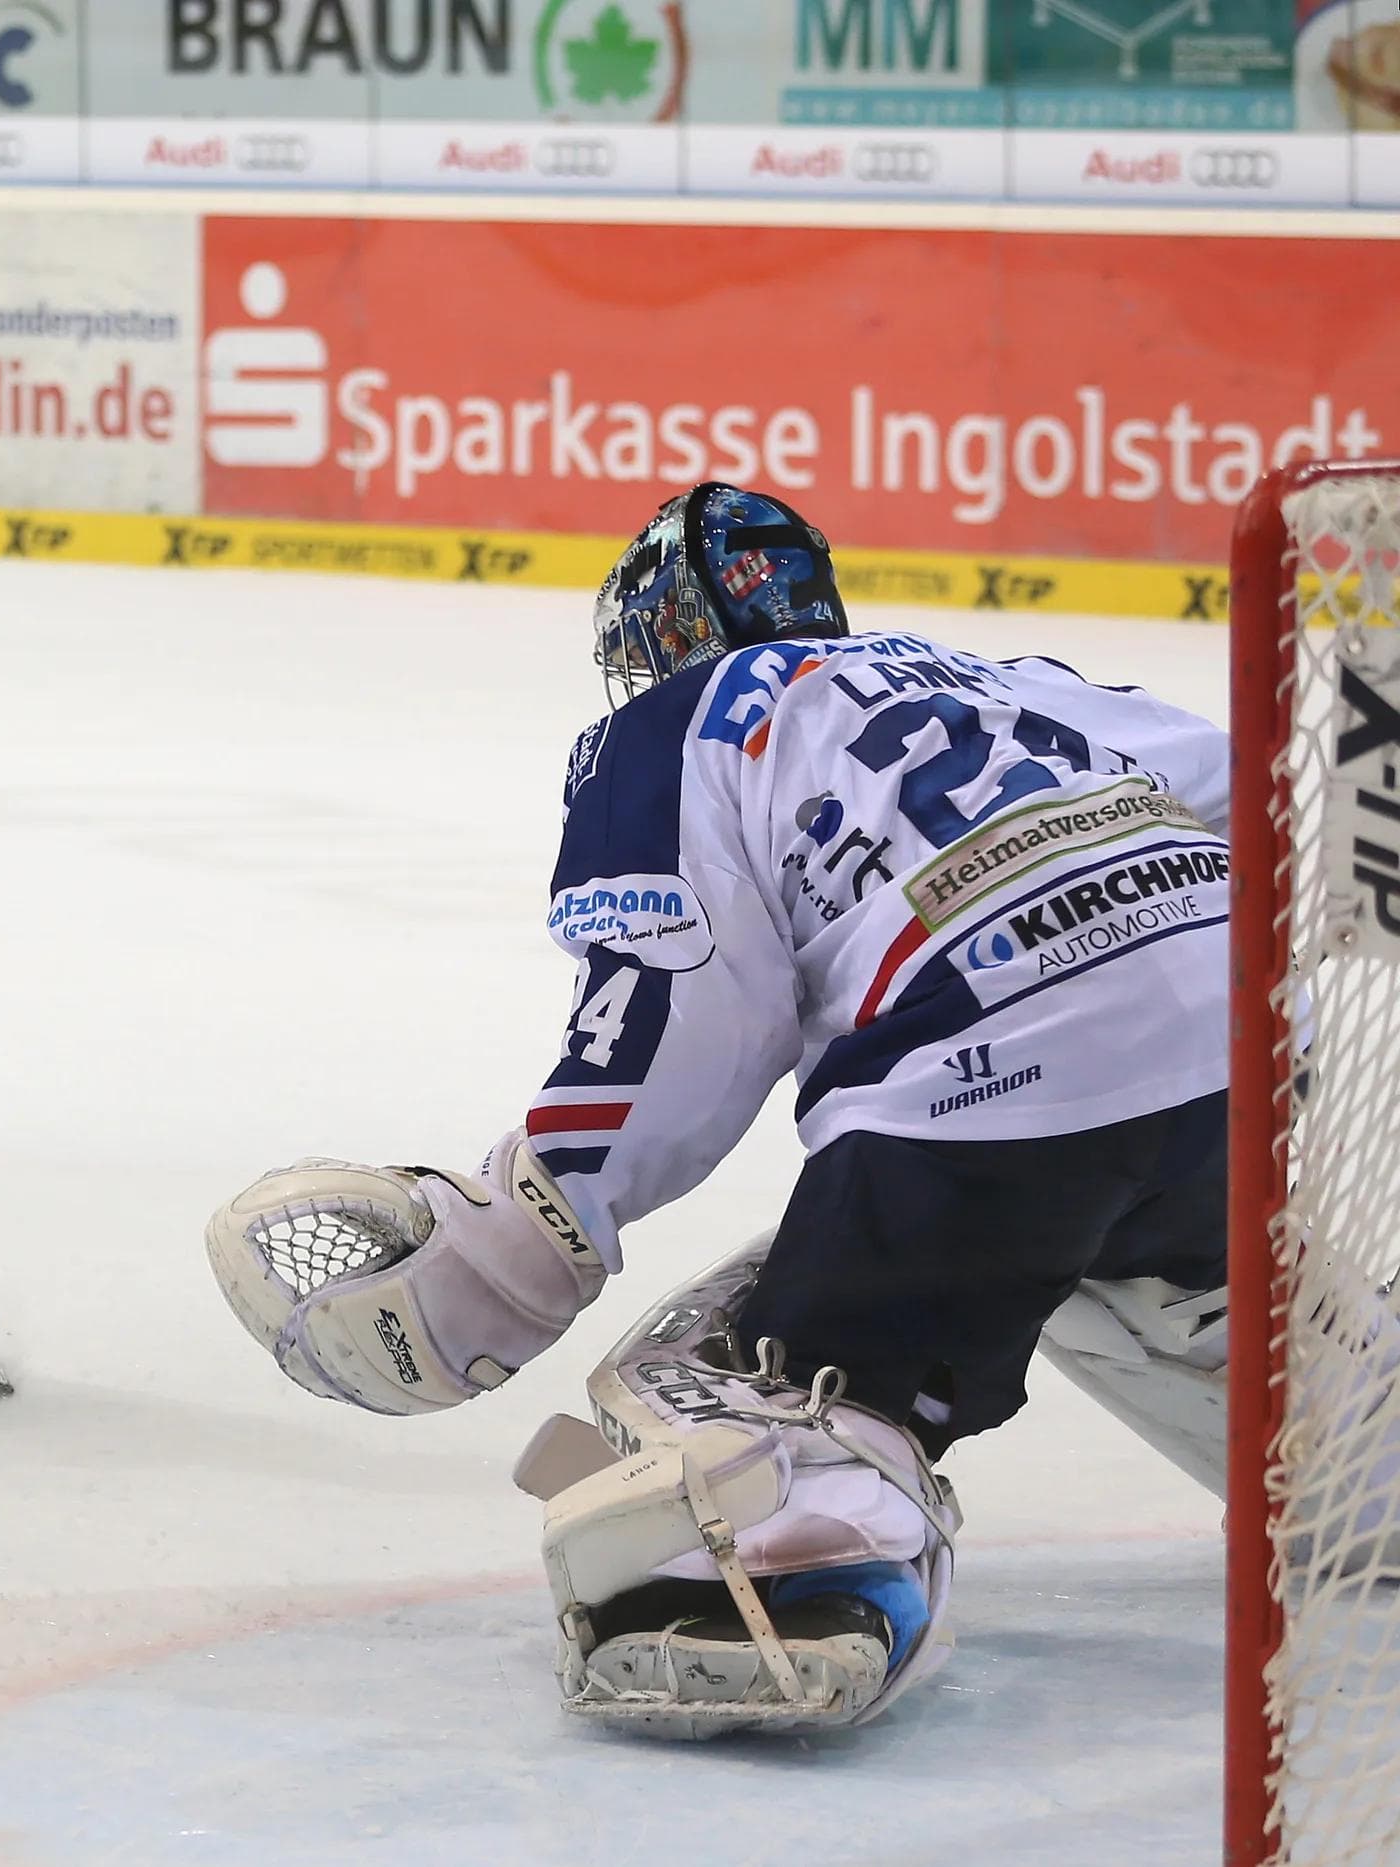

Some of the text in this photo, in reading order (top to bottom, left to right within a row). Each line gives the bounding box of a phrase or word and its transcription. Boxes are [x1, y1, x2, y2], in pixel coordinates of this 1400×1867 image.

[165, 0, 513, 76] BRAUN
[145, 137, 226, 168] Audi
[439, 140, 528, 173] Audi
[751, 145, 844, 178] Audi
[1083, 149, 1182, 184] Audi
[336, 369, 1381, 524] Sparkasse Ingolstadt
[813, 601, 834, 622] 24
[1007, 850, 1230, 951] KIRCHHOF
[1037, 895, 1202, 976] AUTOMOTIVE
[930, 1064, 1042, 1119] WARRIOR
[516, 1174, 588, 1256] CCM
[622, 1458, 660, 1483] LANGE
